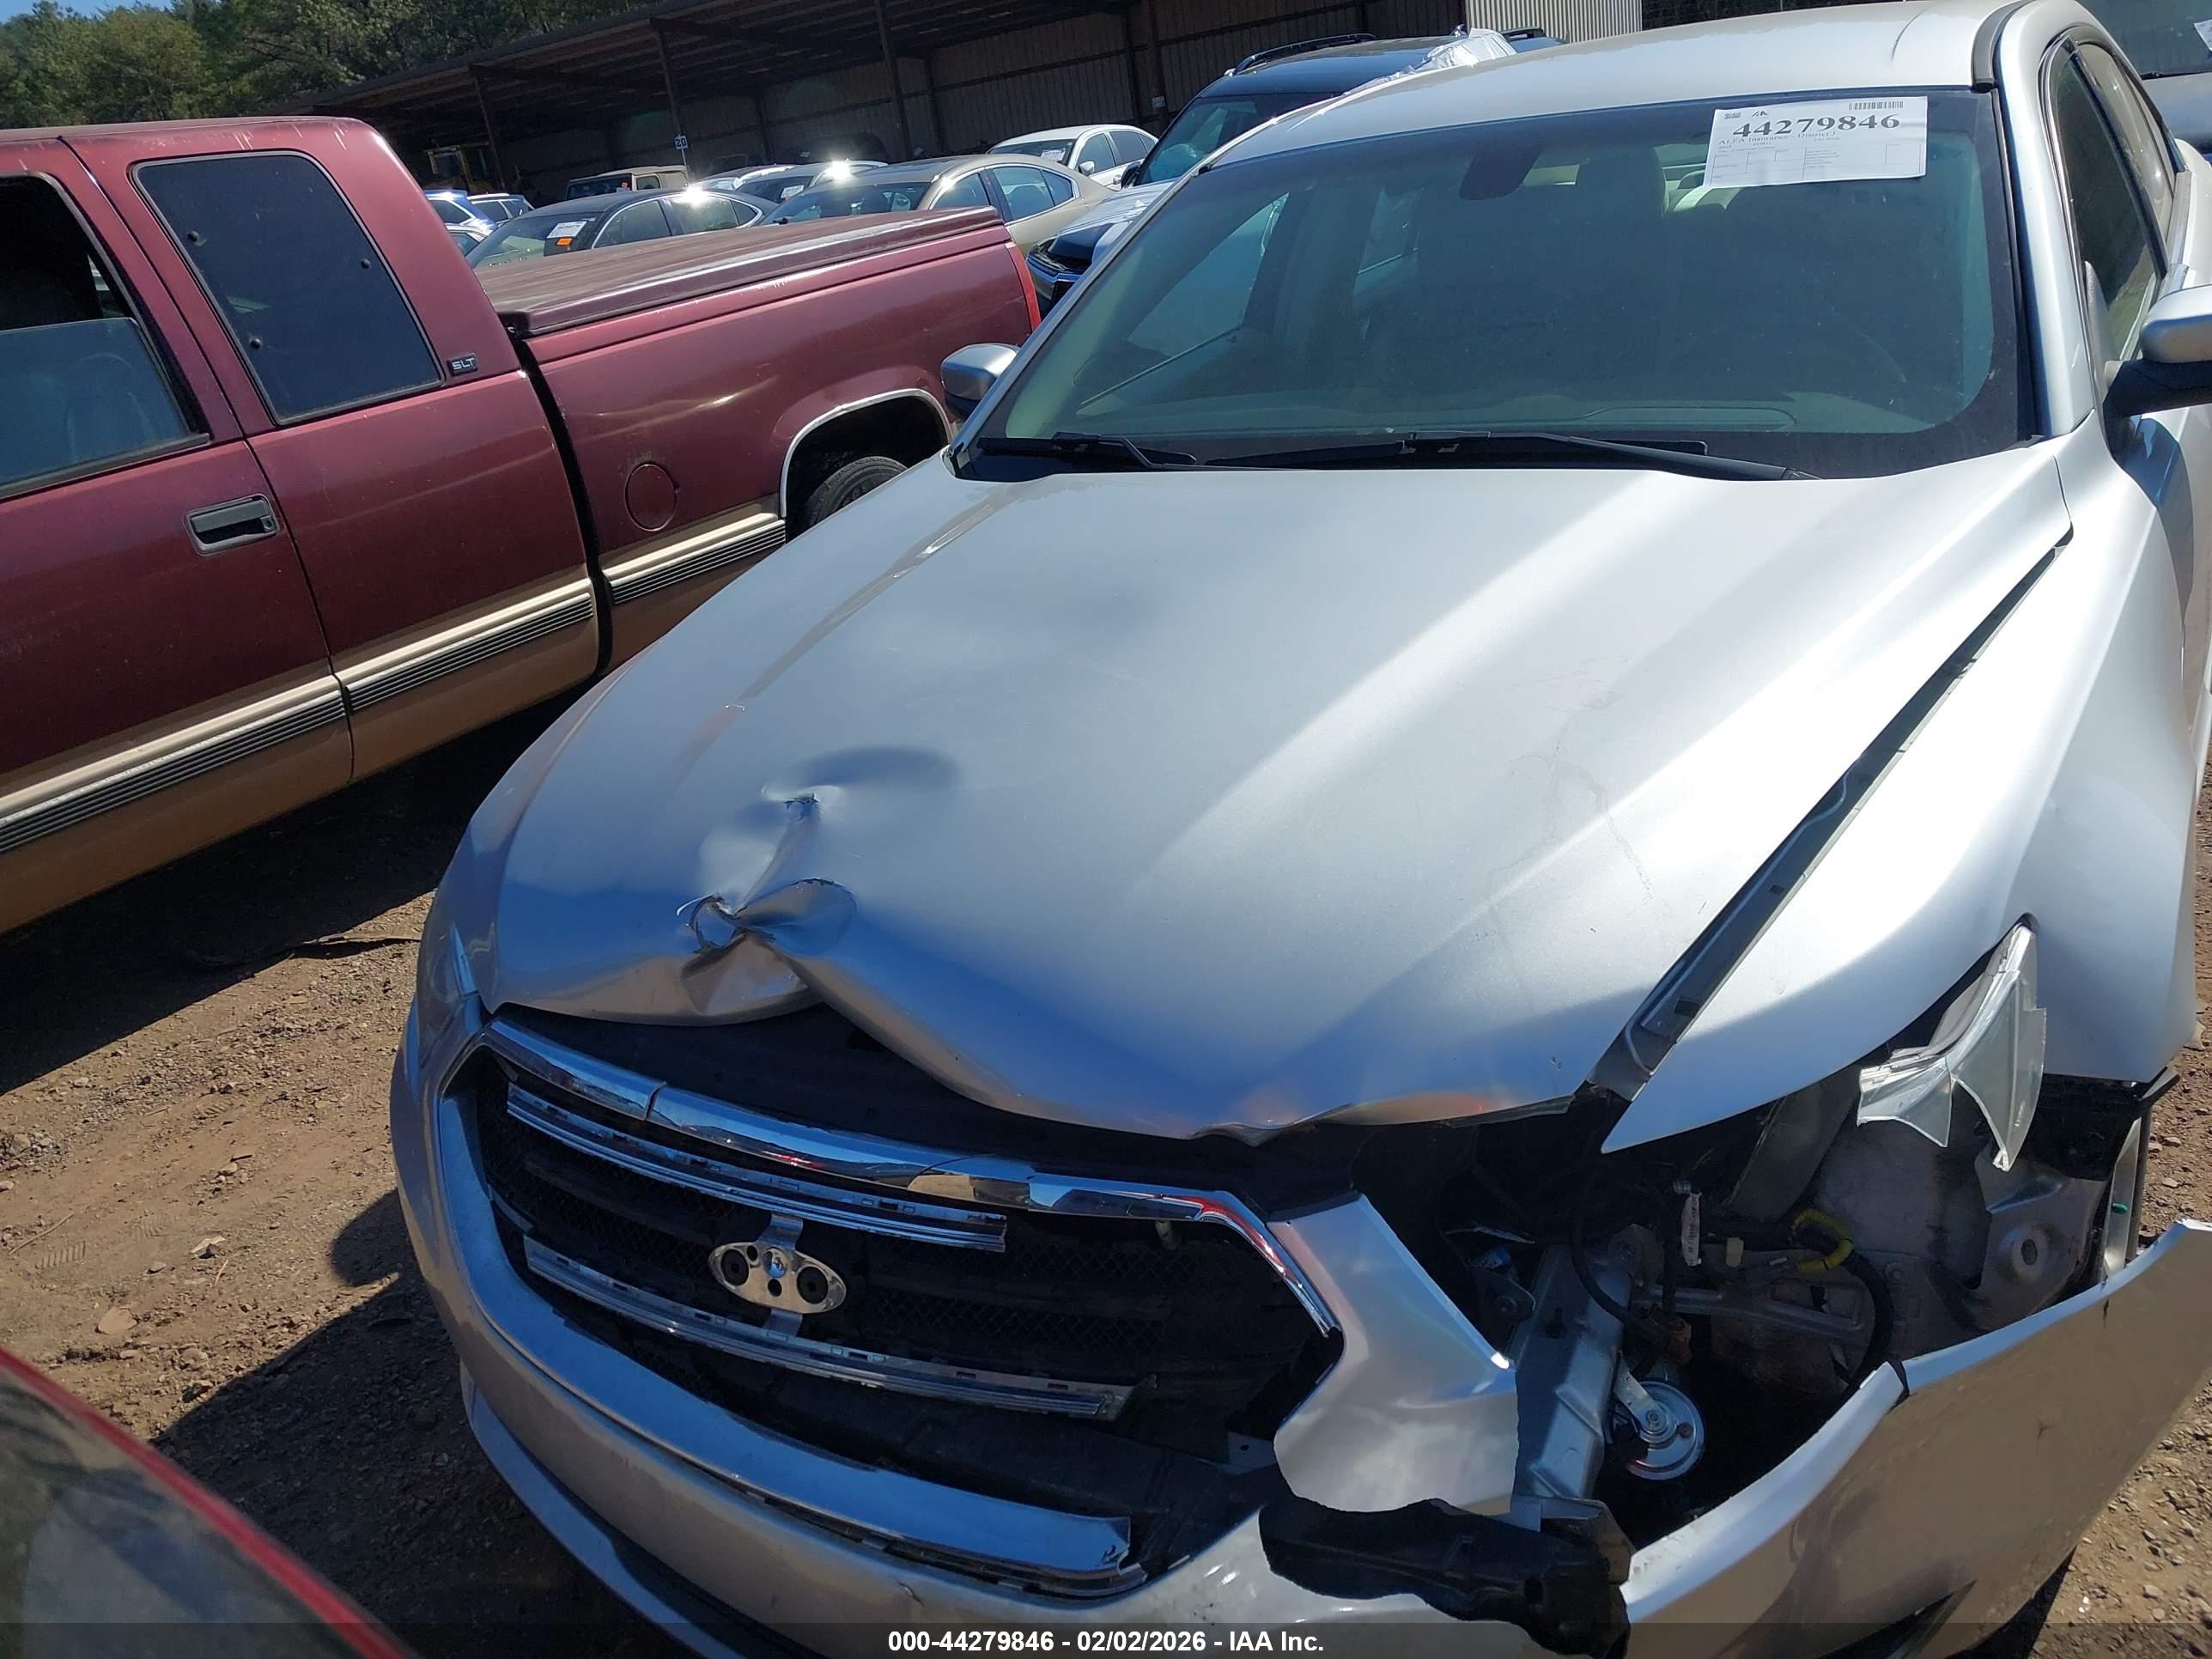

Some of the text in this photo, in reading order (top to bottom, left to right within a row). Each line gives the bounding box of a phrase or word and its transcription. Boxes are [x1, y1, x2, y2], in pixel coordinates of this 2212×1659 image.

[1733, 113, 1900, 137] 44279846
[675, 138, 686, 147] 20
[452, 357, 475, 370] SLT
